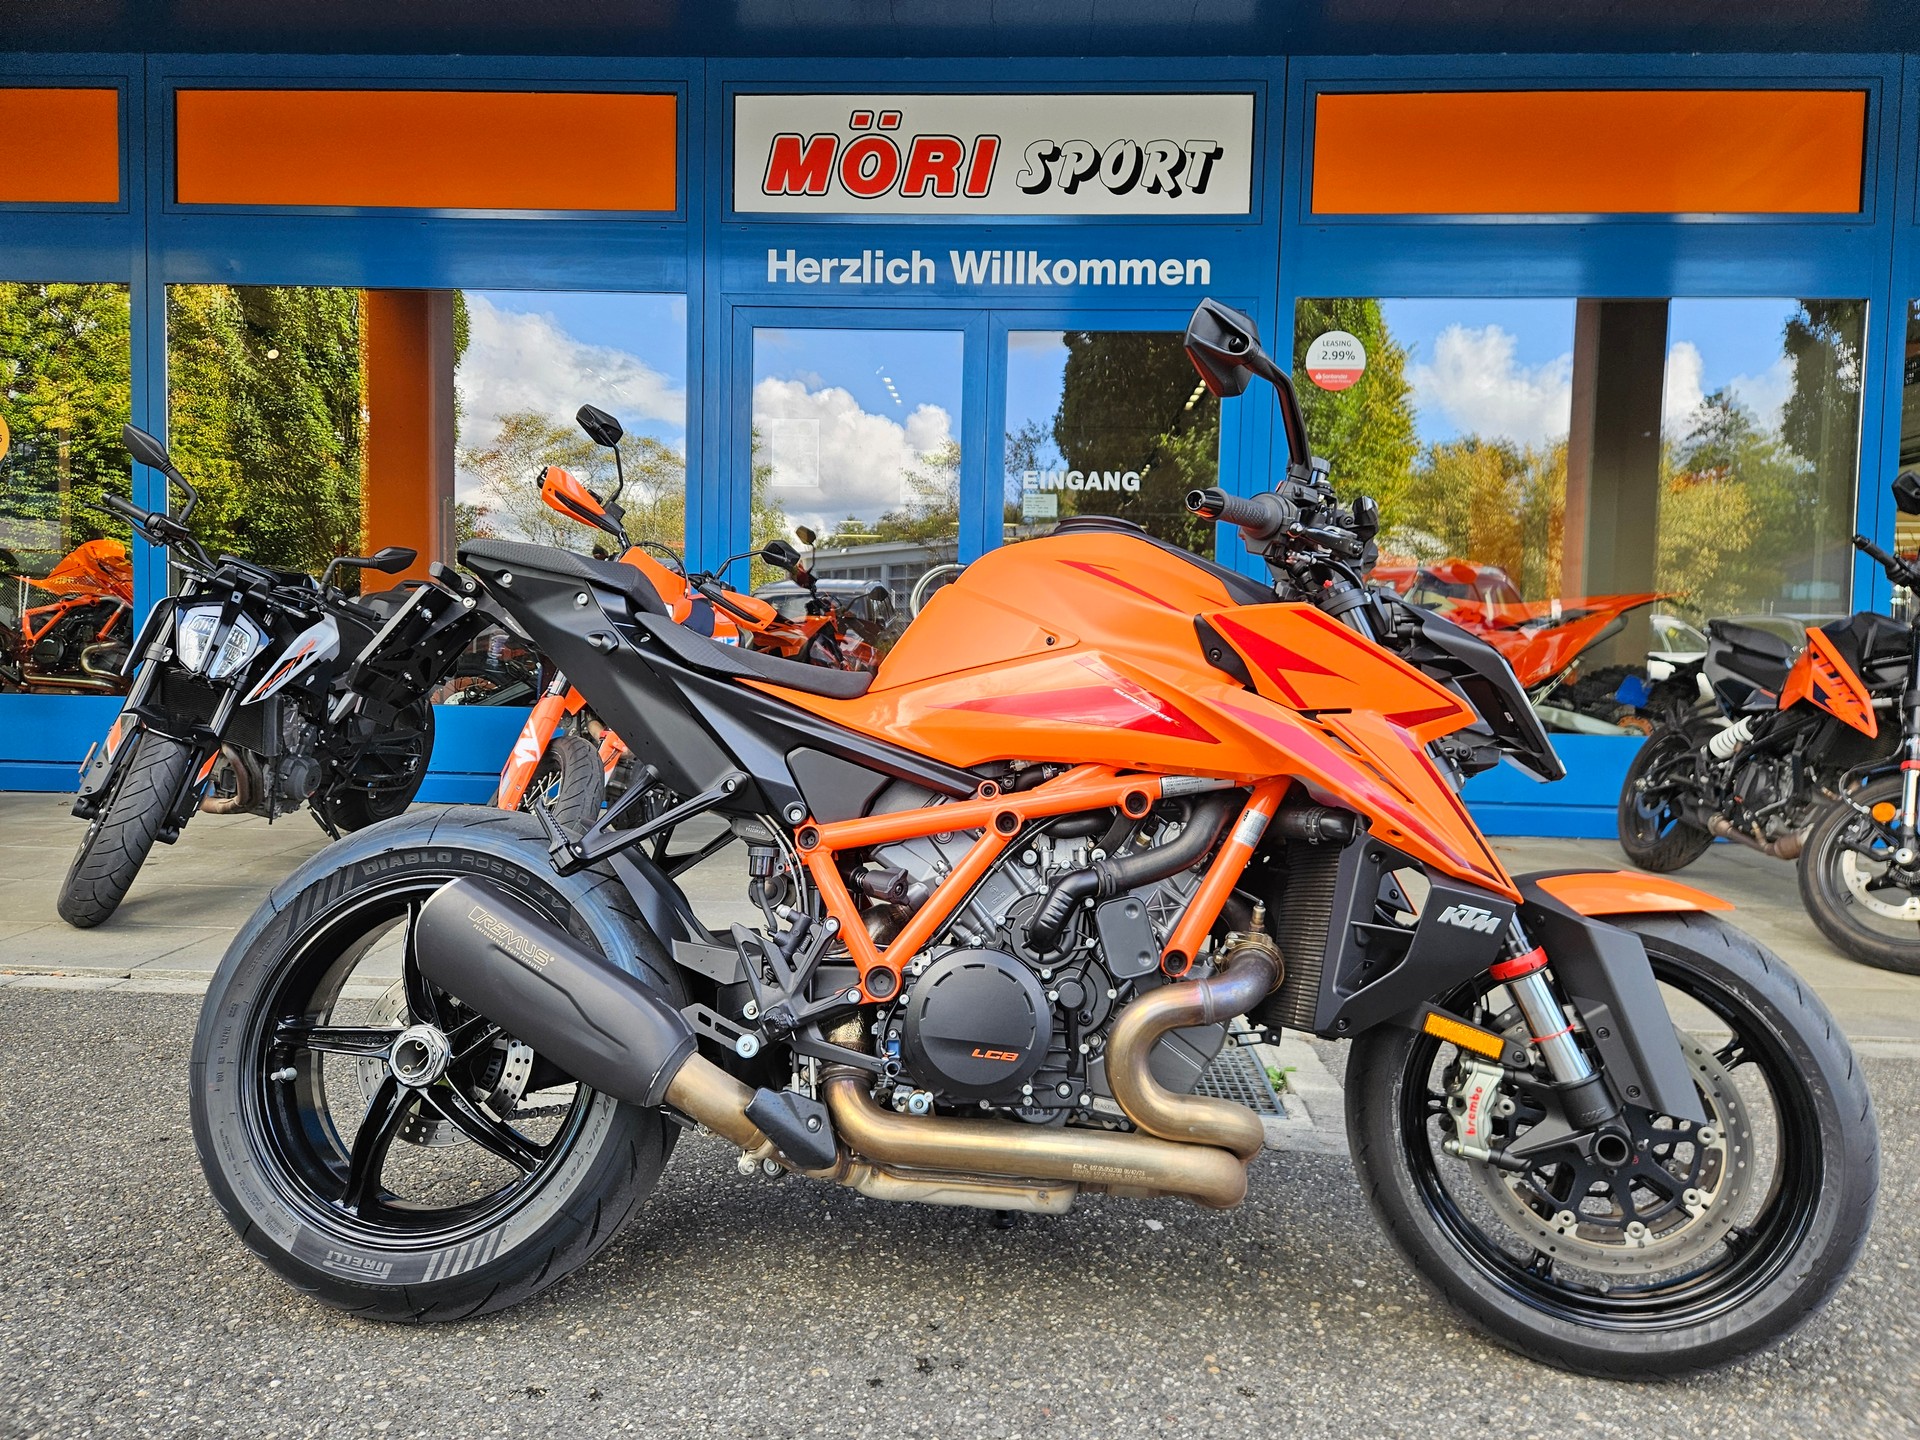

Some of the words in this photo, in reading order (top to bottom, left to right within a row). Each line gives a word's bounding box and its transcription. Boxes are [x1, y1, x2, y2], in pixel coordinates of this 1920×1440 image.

[762, 109, 1001, 199] MÖRI
[1015, 139, 1224, 199] SPORT
[767, 249, 936, 286] Herzlich
[949, 249, 1211, 286] Willkommen
[1321, 350, 1356, 361] 2.99%
[1023, 471, 1140, 491] EINGANG
[361, 851, 452, 876] DIABLO
[460, 854, 531, 887] ROSSO
[1437, 904, 1502, 935] KTM
[476, 913, 550, 967] REMUS
[1465, 1086, 1483, 1137] brembo
[322, 1250, 393, 1280] PIRELLI
